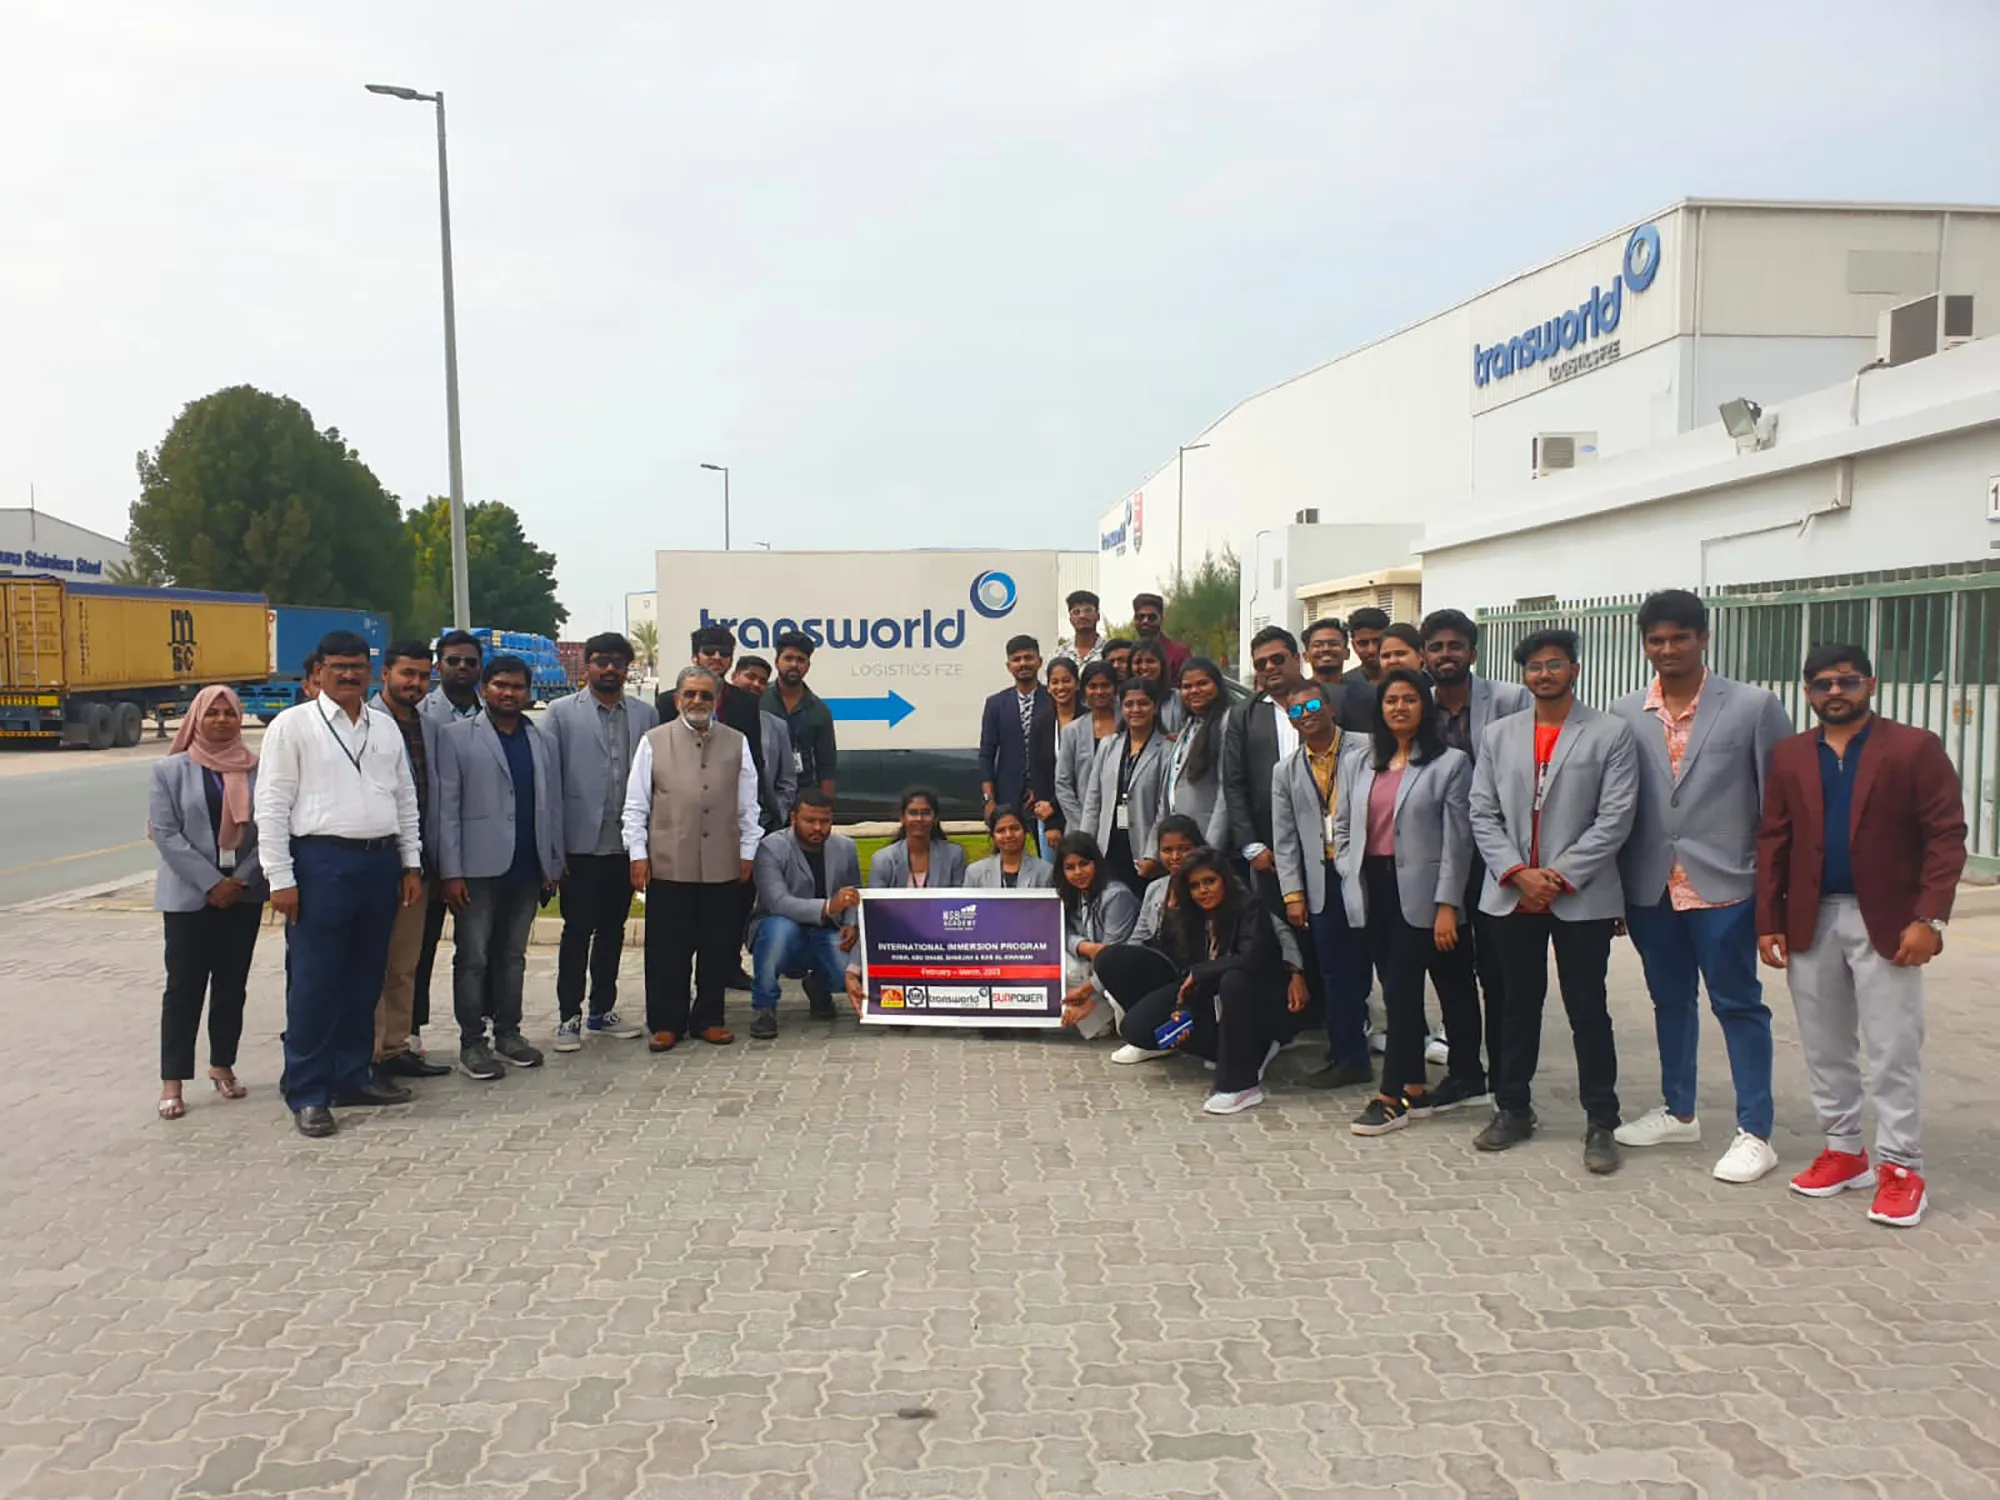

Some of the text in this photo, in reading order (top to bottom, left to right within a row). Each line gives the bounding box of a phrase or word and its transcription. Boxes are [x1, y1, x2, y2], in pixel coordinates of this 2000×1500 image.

[1473, 275, 1622, 388] transworld
[25, 550, 74, 571] Stainless
[851, 663, 965, 677] LOGISTICS FZE
[878, 942, 1047, 951] INTERNATIONAL IMMERSION PROGRAM
[928, 995, 980, 1003] transworld
